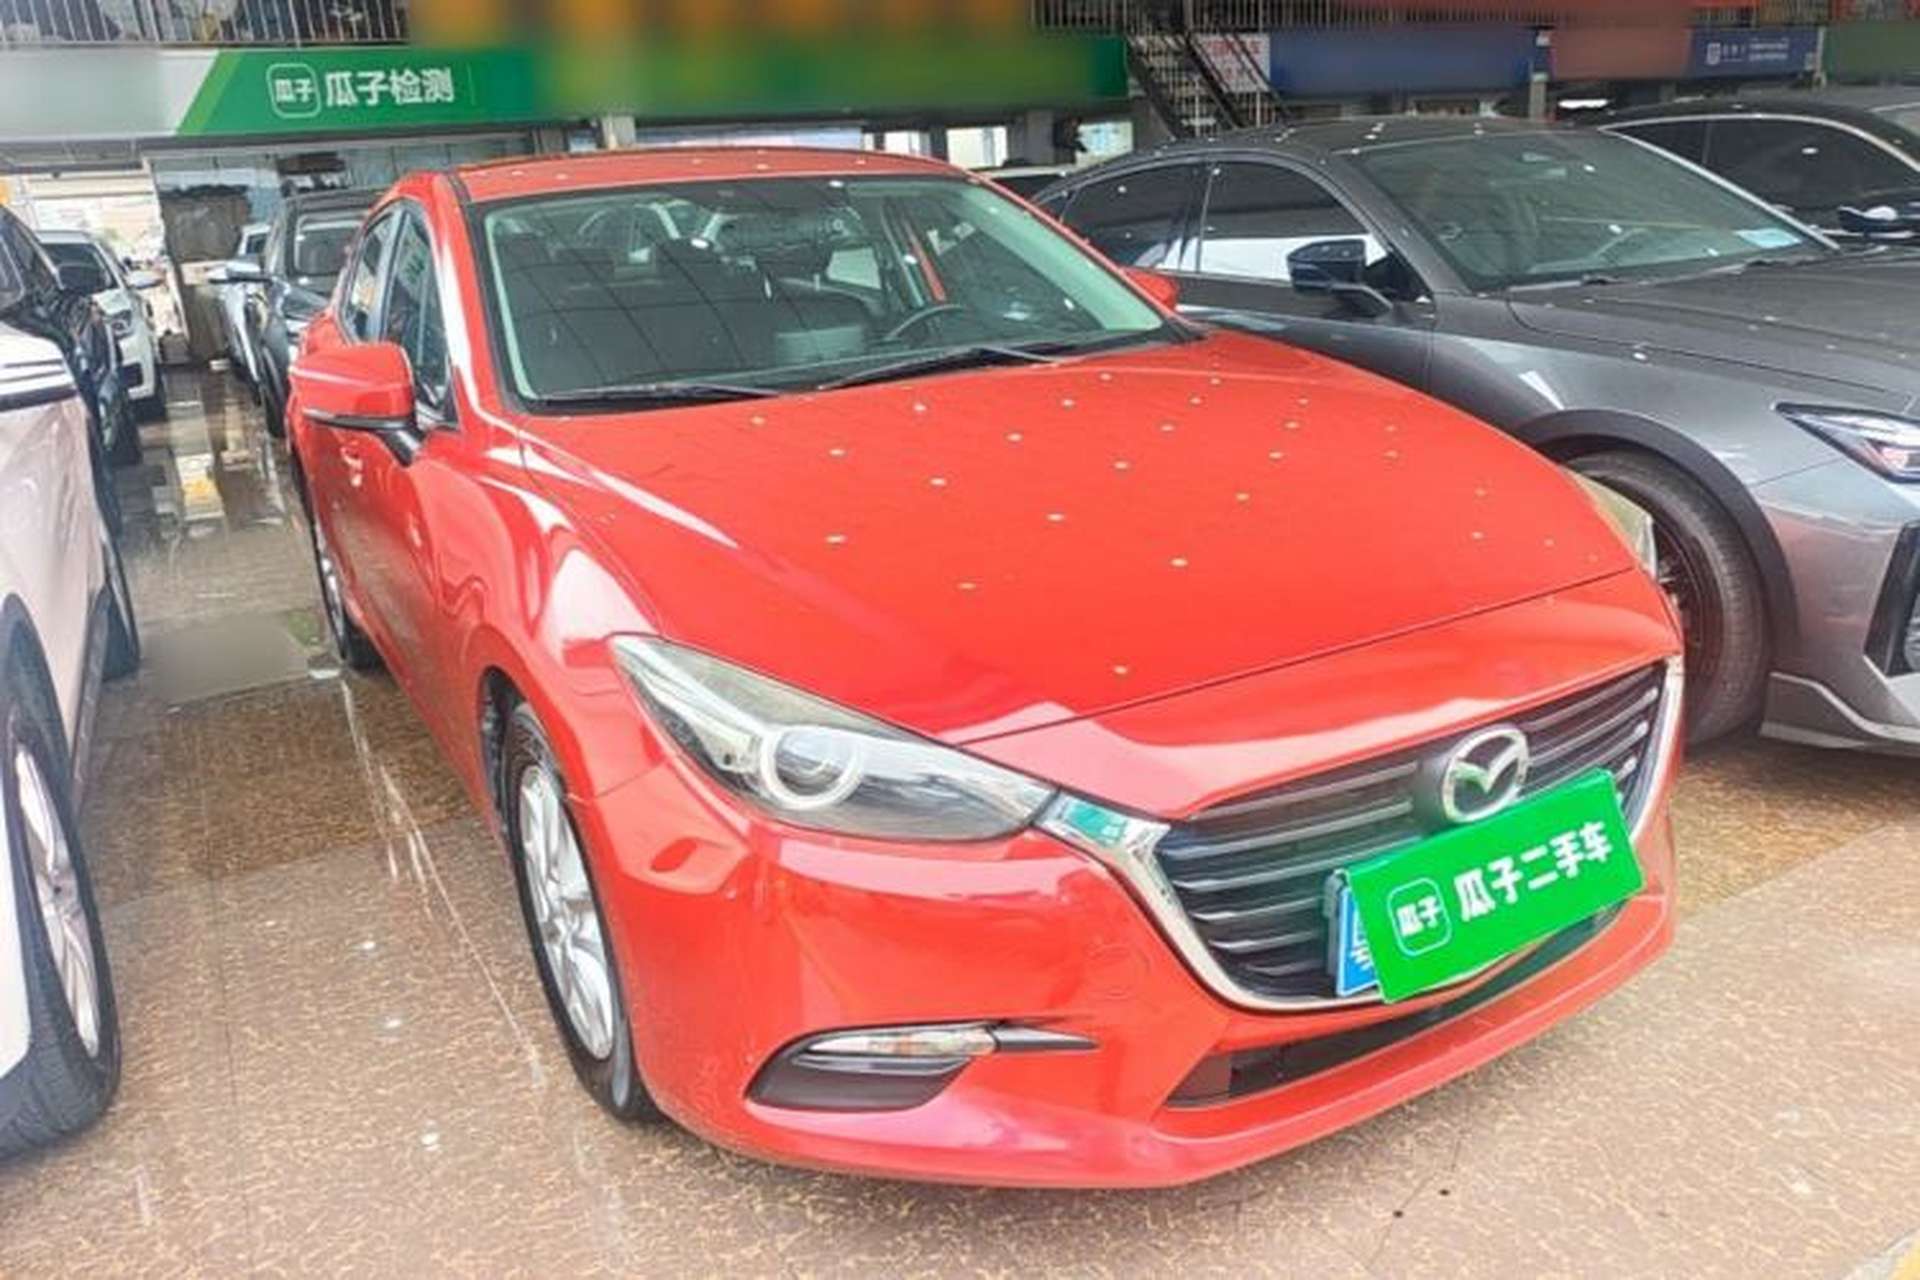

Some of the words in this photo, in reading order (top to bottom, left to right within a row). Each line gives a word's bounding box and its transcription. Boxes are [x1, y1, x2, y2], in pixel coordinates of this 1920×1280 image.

[325, 68, 455, 107] 瓜子检测
[1453, 820, 1614, 923] 瓜子二手车
[1396, 895, 1443, 937] 瓜子
